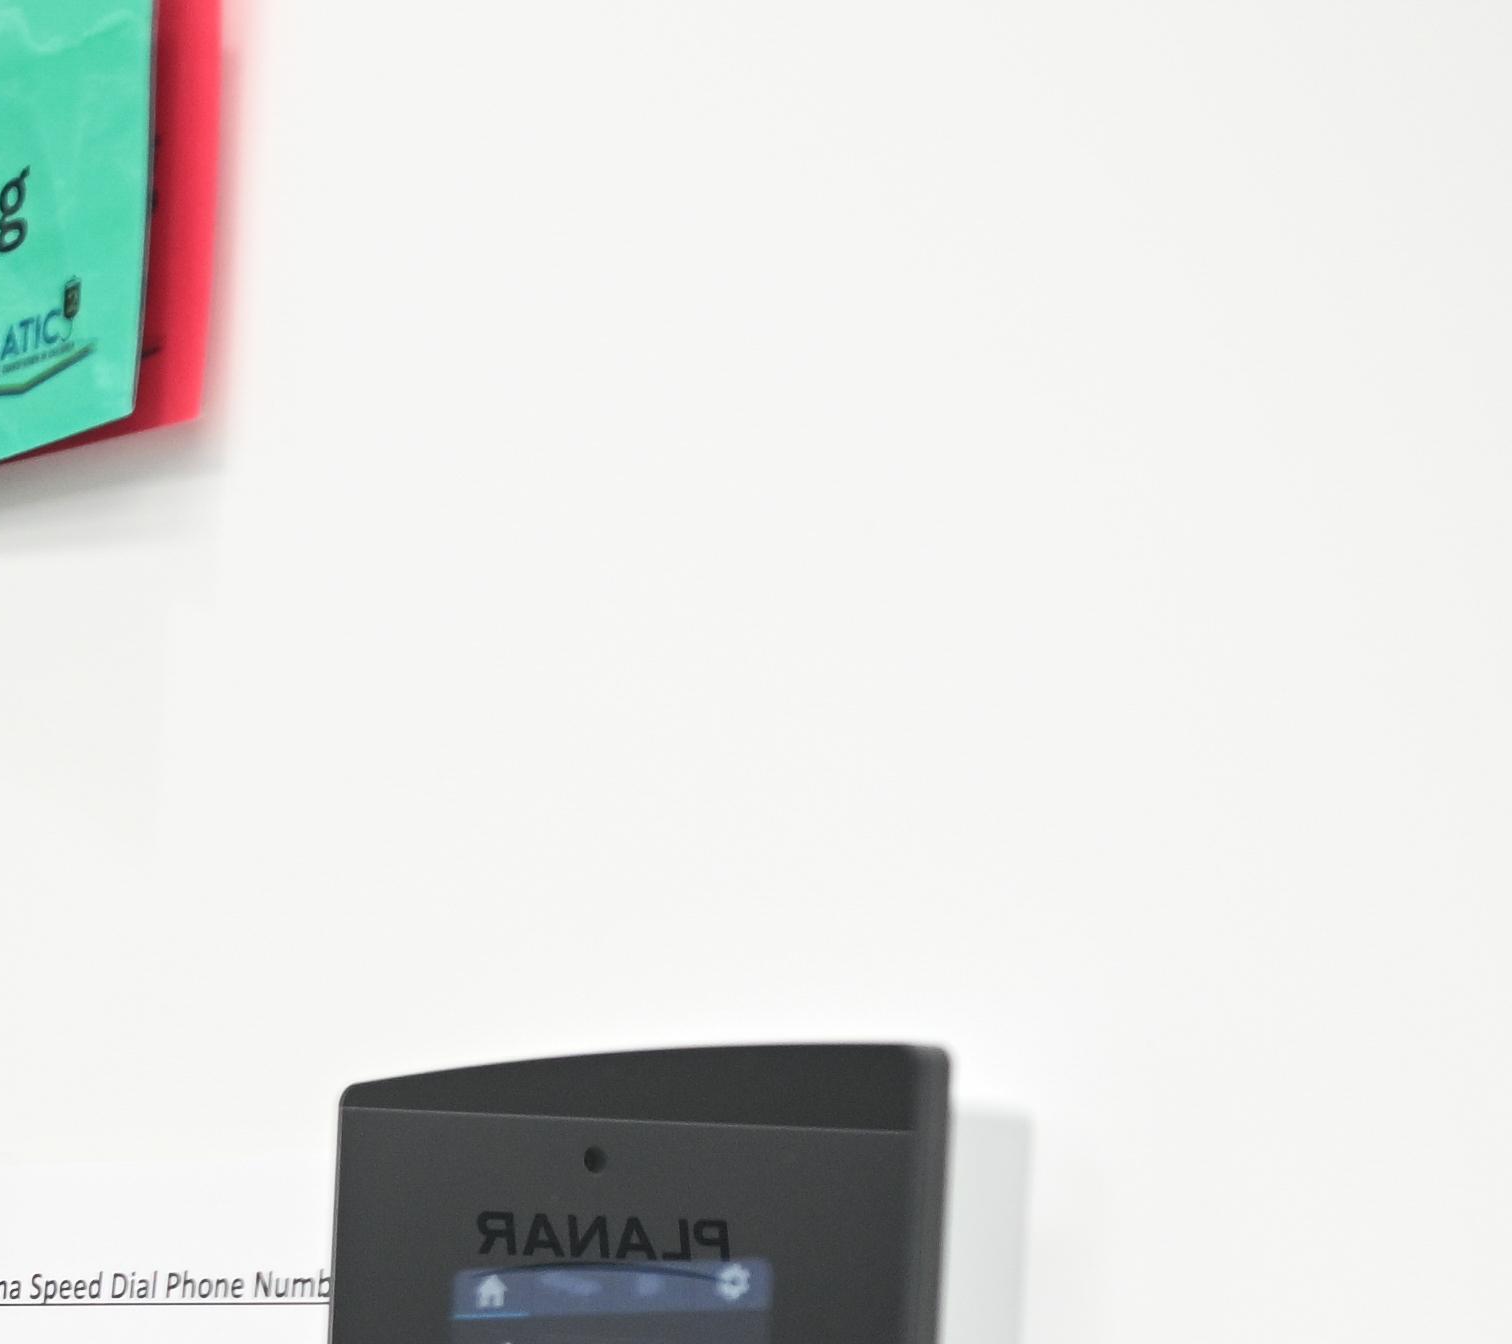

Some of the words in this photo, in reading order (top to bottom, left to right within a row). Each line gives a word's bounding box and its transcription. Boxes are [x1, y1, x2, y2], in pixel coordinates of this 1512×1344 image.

[31, 1270, 102, 1304] Speed
[110, 1270, 158, 1300] Dial
[165, 1270, 245, 1300] Phone
